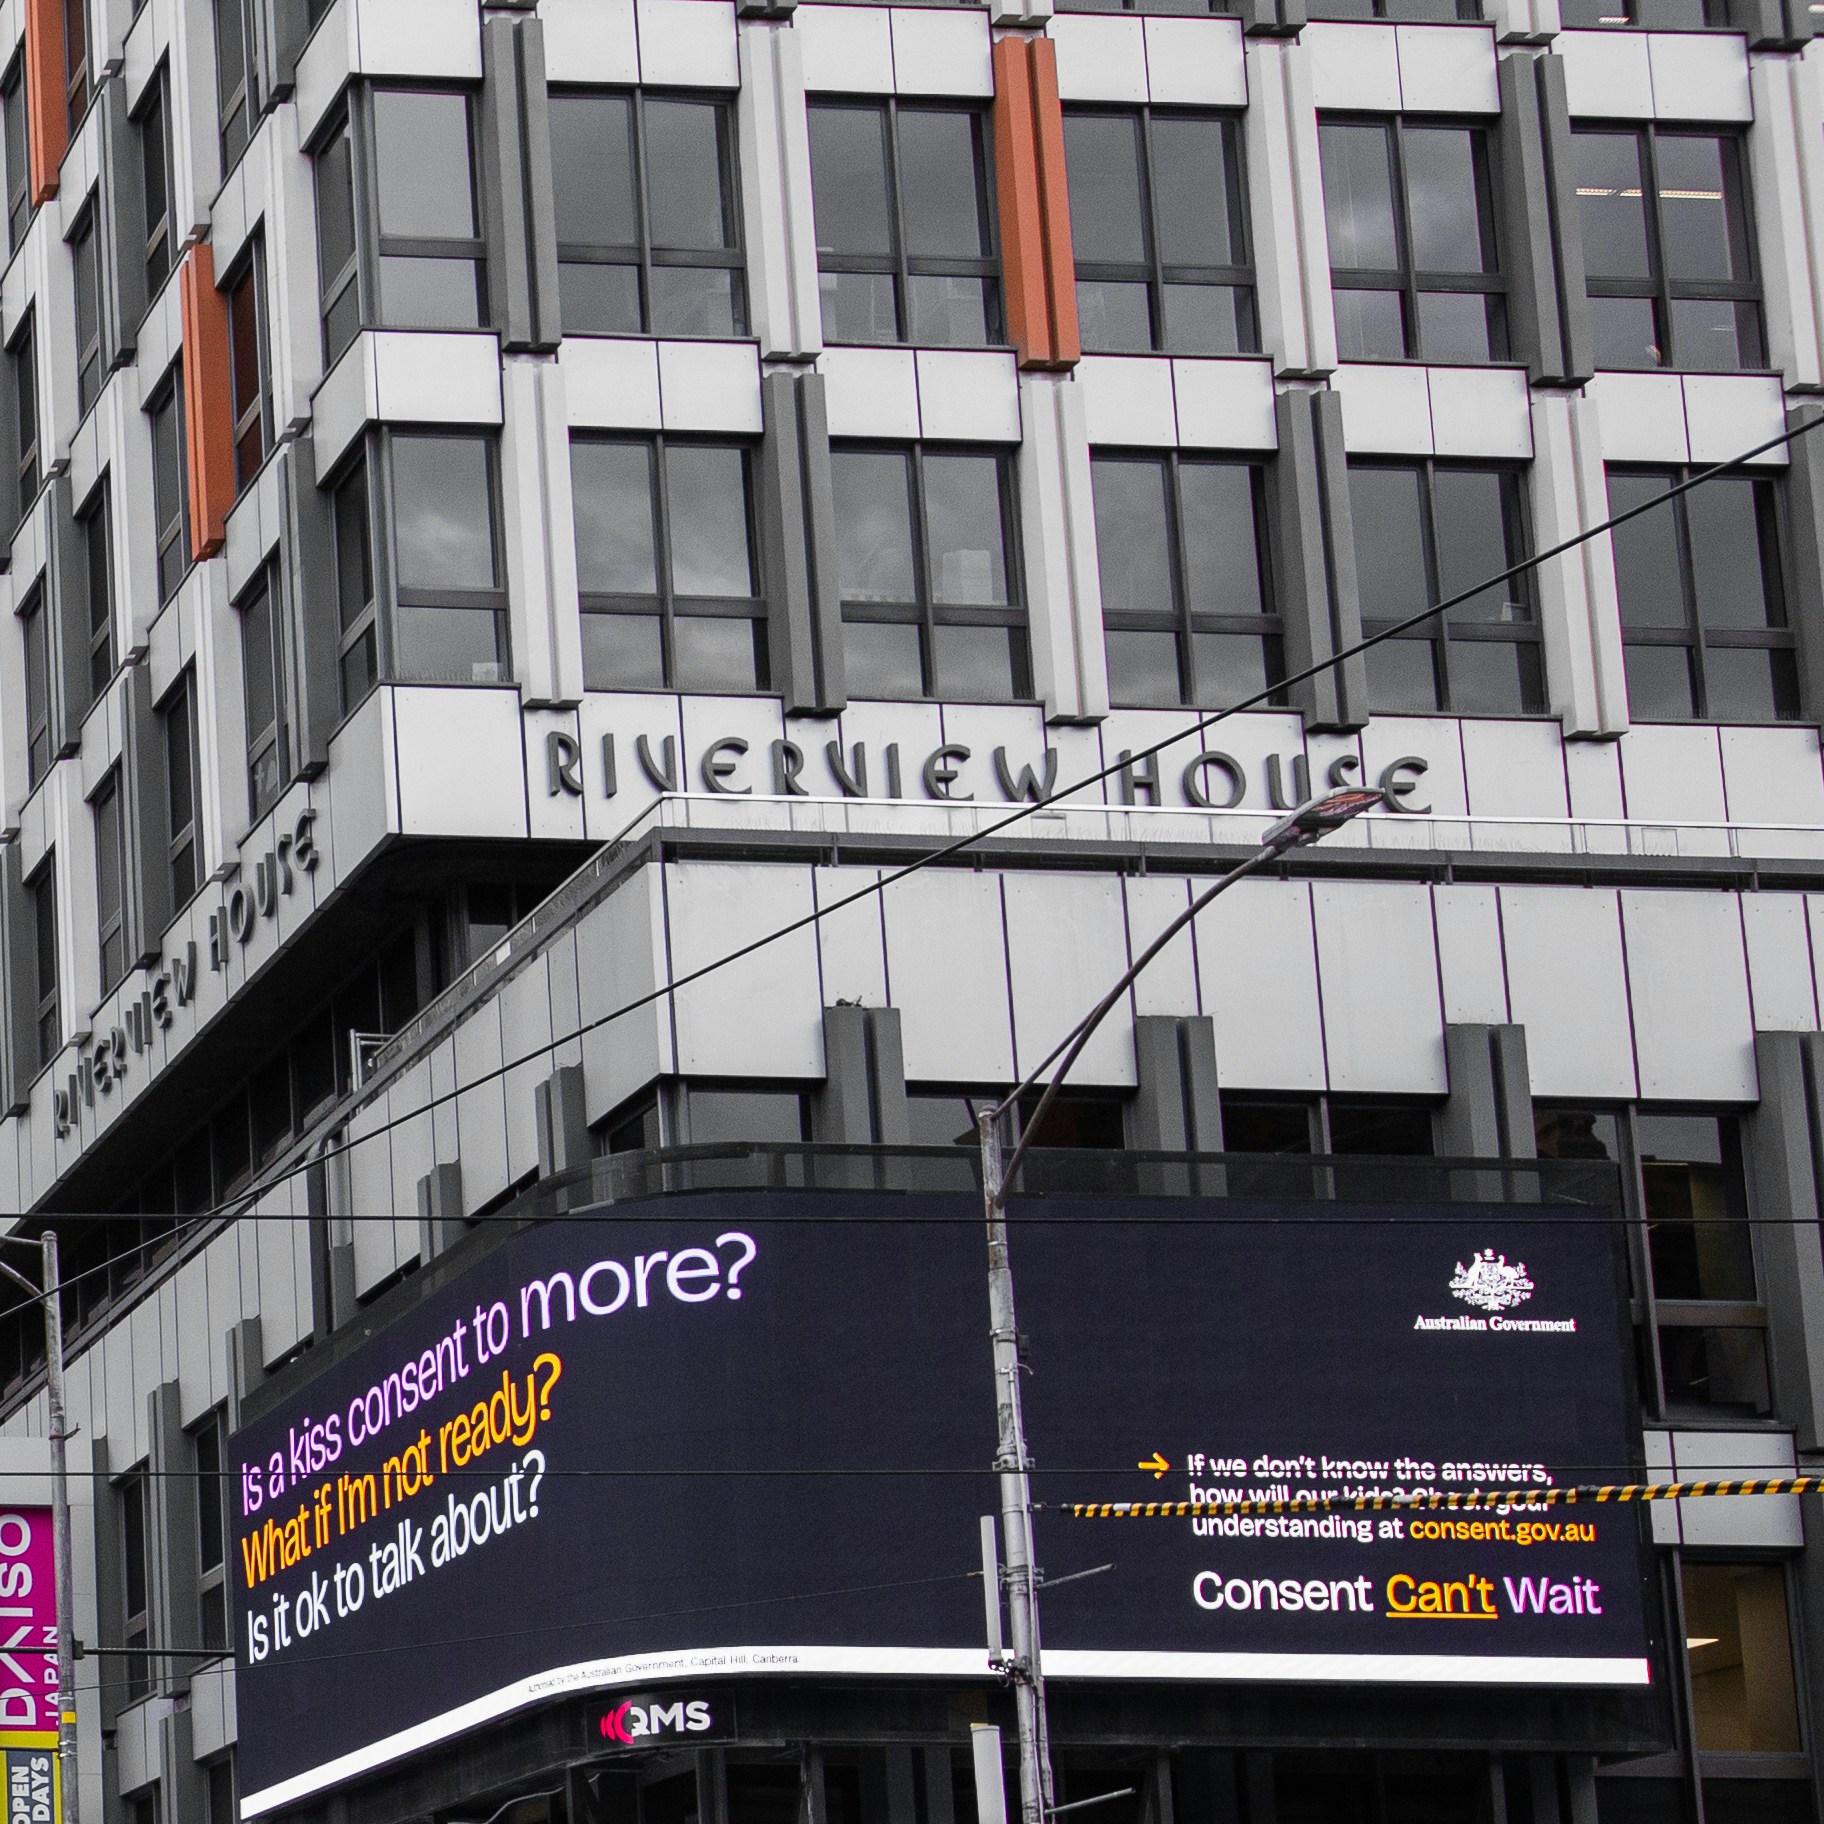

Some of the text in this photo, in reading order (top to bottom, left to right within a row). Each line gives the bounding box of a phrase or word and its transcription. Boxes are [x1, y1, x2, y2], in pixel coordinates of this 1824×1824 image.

[546, 731, 1433, 816] RIVERVIEW HOUSE
[54, 808, 319, 1140] RIVERVIEW HOUSE
[1414, 1313, 1577, 1333] Australian Government
[268, 1230, 758, 1495] a kiss consent to more?
[241, 1352, 564, 1589] What if I'm not ready?
[1187, 1454, 1555, 1486] If we don't know the answers,
[1189, 1483, 1338, 1504] how will our
[273, 1588, 291, 1653] it
[295, 1570, 330, 1639] ok
[333, 1552, 366, 1619] to
[370, 1520, 426, 1601] talk
[430, 1448, 548, 1570] about?
[1192, 1514, 1596, 1545] understanding at consent.gov.au
[1192, 1570, 1603, 1615] Consent Can't Wait
[690, 1656, 727, 1667] Capital
[31, 1756, 50, 1821] DAYS
